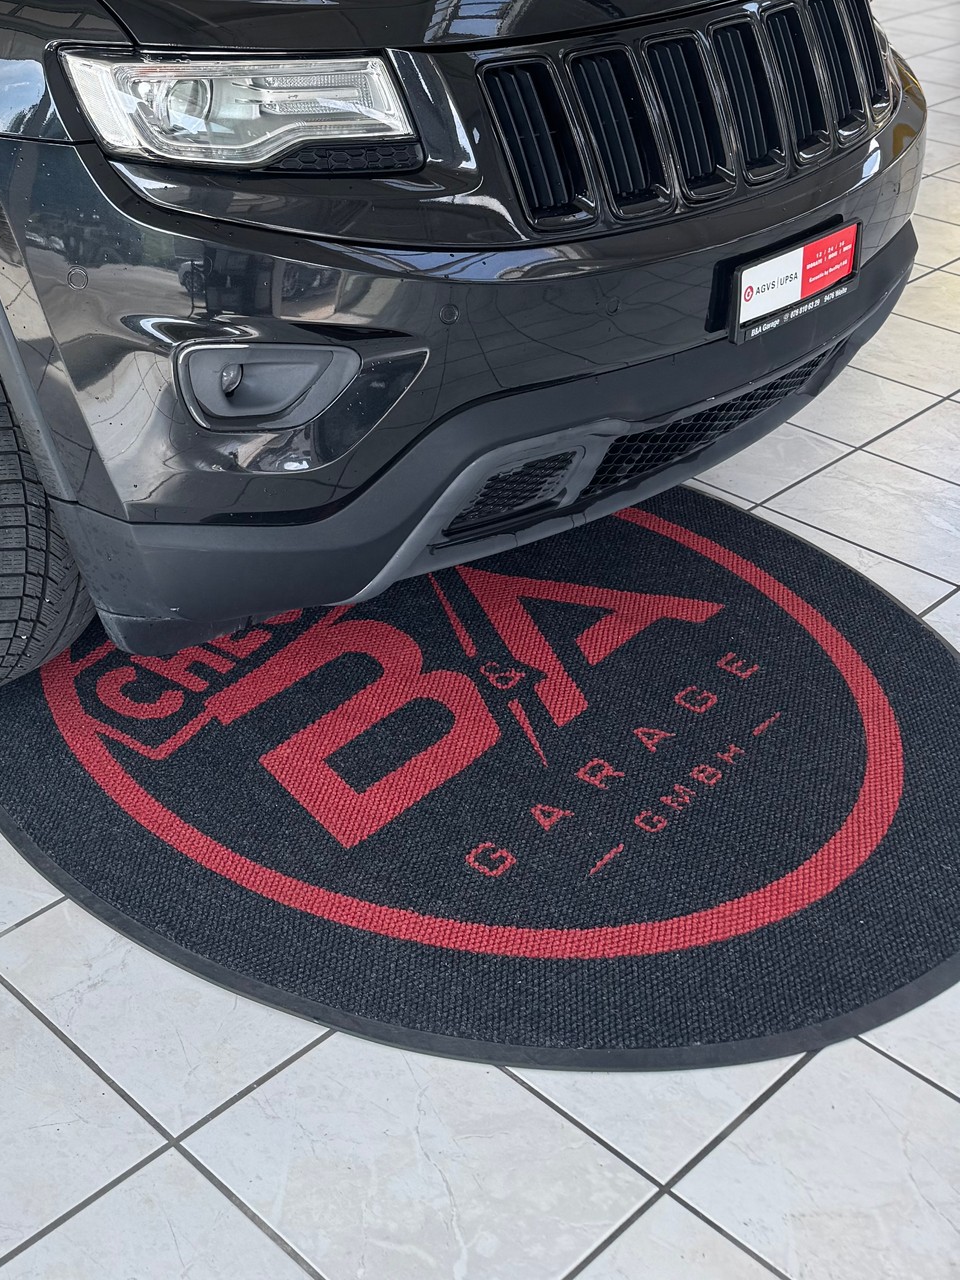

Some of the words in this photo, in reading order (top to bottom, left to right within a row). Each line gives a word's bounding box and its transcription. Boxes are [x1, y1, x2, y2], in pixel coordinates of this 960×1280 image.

[762, 318, 780, 332] Garage
[465, 652, 760, 877] GARAGE
[634, 744, 745, 833] GMBH
